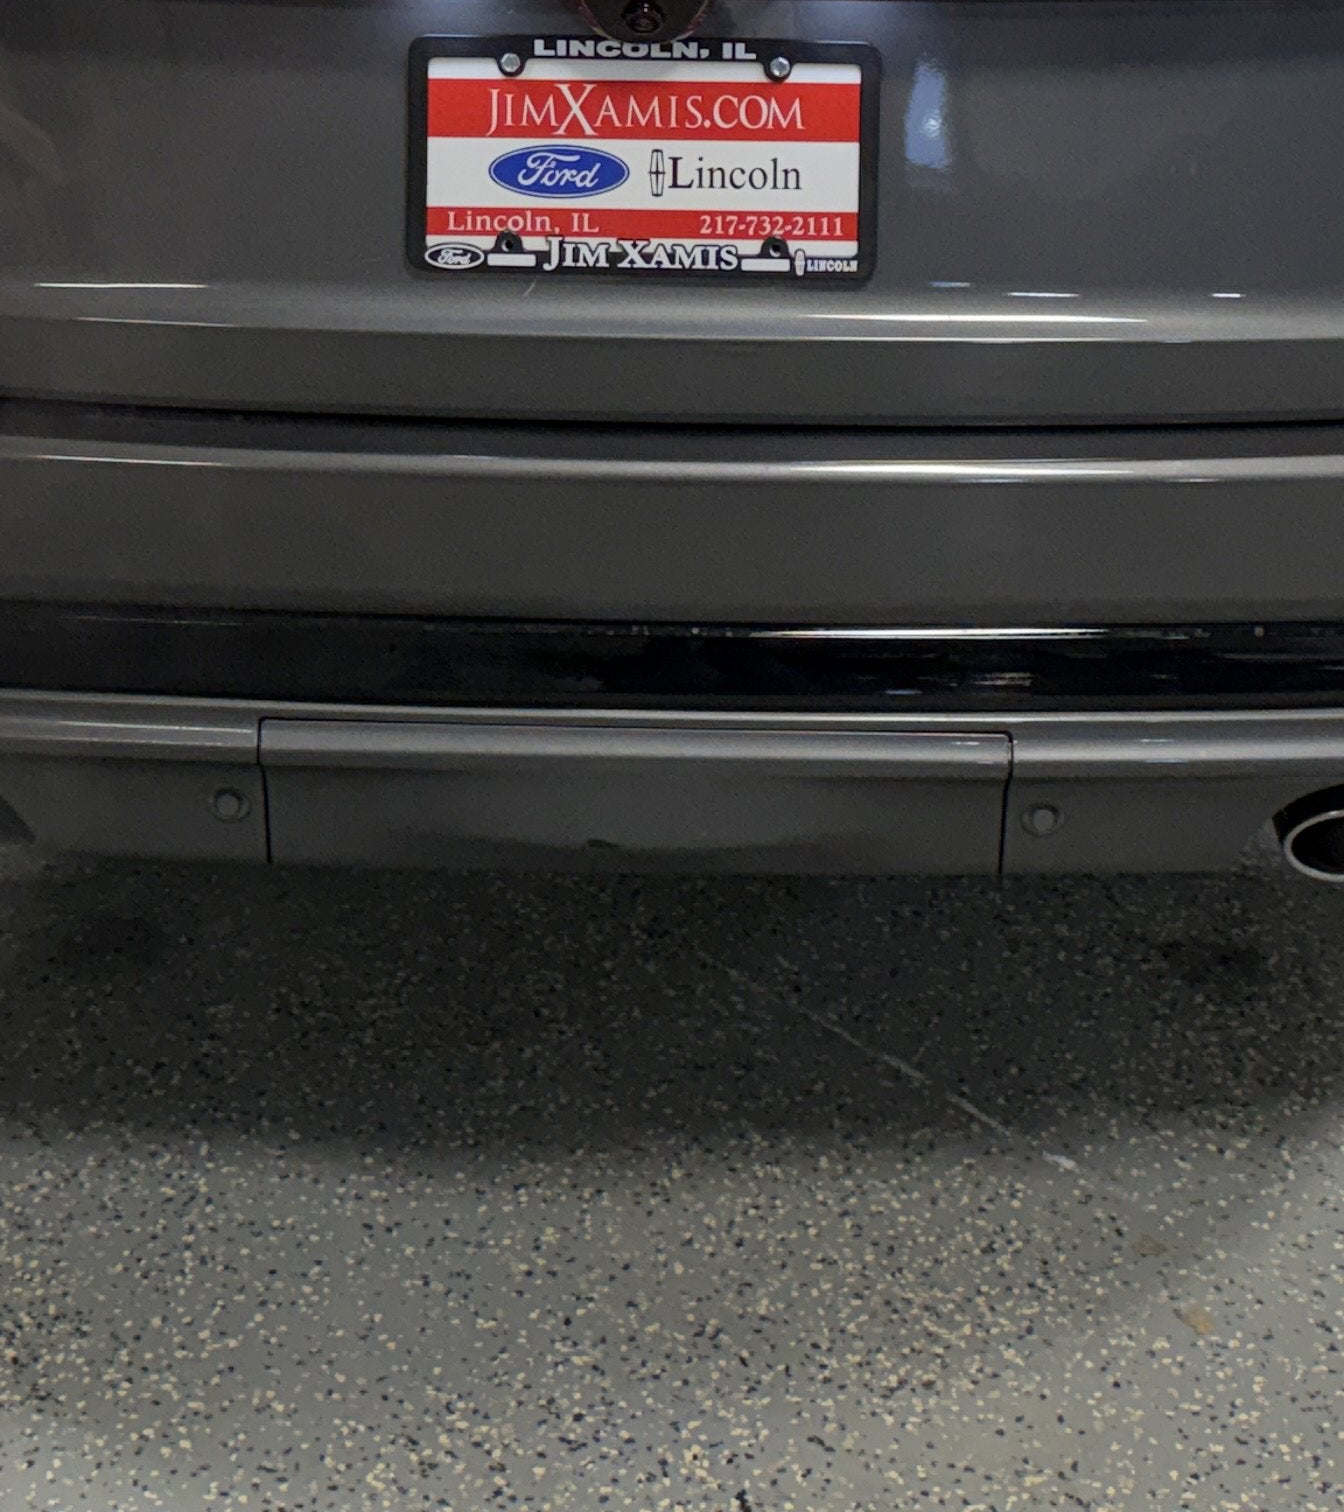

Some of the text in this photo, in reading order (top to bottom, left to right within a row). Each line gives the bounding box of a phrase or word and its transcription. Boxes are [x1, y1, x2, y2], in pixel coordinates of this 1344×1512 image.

[533, 39, 757, 60] LINCOLN, IL
[486, 83, 805, 136] JIMXAMIS.COM
[517, 151, 600, 190] Ford
[668, 156, 803, 191] Lincoln
[572, 213, 600, 233] IL
[699, 215, 844, 238] 217-732-2111
[542, 236, 738, 272] JIM XAMIS
[806, 259, 858, 272] LINCOLN
